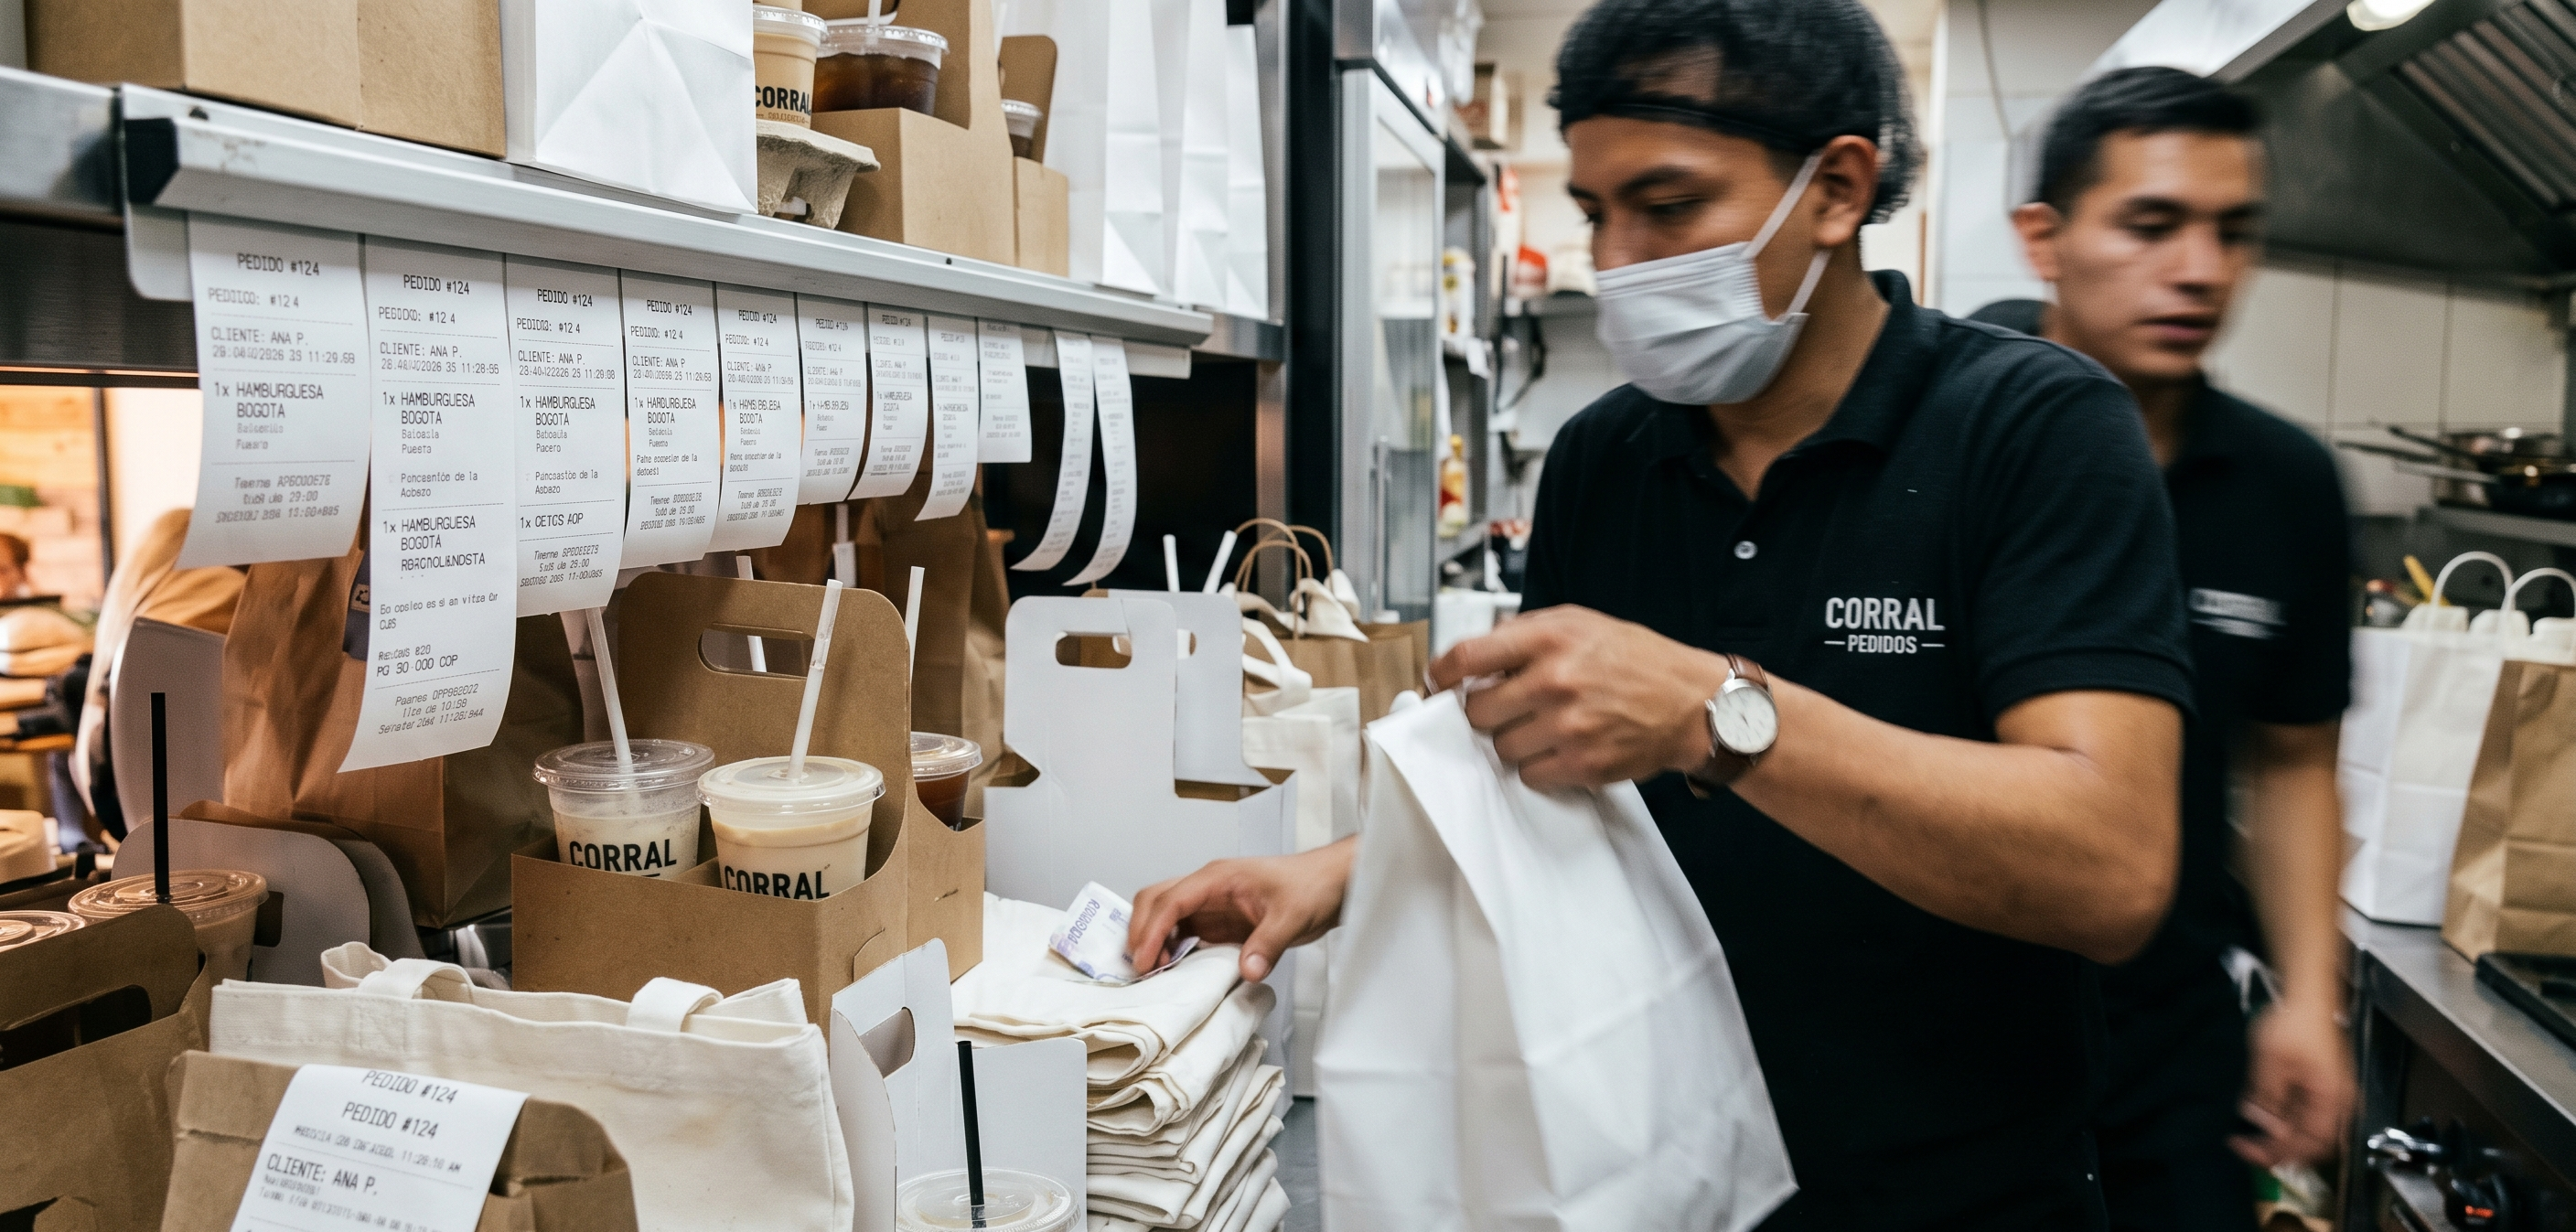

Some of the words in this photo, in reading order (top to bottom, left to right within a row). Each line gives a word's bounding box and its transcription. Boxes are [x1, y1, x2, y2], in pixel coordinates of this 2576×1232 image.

[237, 252, 284, 273] PEDIDO
[290, 261, 319, 276] #124
[403, 274, 441, 292] PEDIDO
[446, 281, 470, 295] #124
[537, 288, 568, 304] PEDIDO
[210, 326, 265, 343] CLIENTE:
[270, 331, 292, 345] ANA
[380, 342, 425, 356] CLIENTE:
[430, 345, 448, 358] ANA
[452, 346, 462, 358] P.
[518, 350, 555, 363] CLIENTE:
[559, 353, 574, 364] ANA
[577, 353, 585, 366] P.
[632, 355, 663, 367] CLIENTE:
[214, 382, 230, 397] 1x
[236, 381, 324, 400] HAMBURGUESA
[382, 391, 395, 405] 1x
[401, 391, 476, 407] HAMBURGUESA
[520, 396, 531, 408] 1x
[237, 402, 285, 418] BOGOTA
[401, 411, 443, 424] BOGOTA
[535, 412, 570, 425] BOGOTA
[455, 472, 466, 481] de
[469, 471, 478, 481] la
[579, 470, 588, 479] de
[382, 520, 396, 534] 1x
[401, 515, 476, 532] HAMBURGUESA
[520, 517, 531, 529] 1x
[1825, 596, 1946, 630] CORRAL
[1848, 634, 1917, 654] PEDIDOS
[439, 654, 458, 668] COP
[569, 838, 677, 872] CORRAL
[724, 865, 830, 900] CORRAL
[362, 1070, 418, 1094] PEDIDO
[421, 1083, 459, 1104] #124
[341, 1101, 398, 1130] PEDIDO
[402, 1117, 440, 1141] #124
[266, 1152, 327, 1184] CLIENTE:
[333, 1169, 359, 1190] ANA
